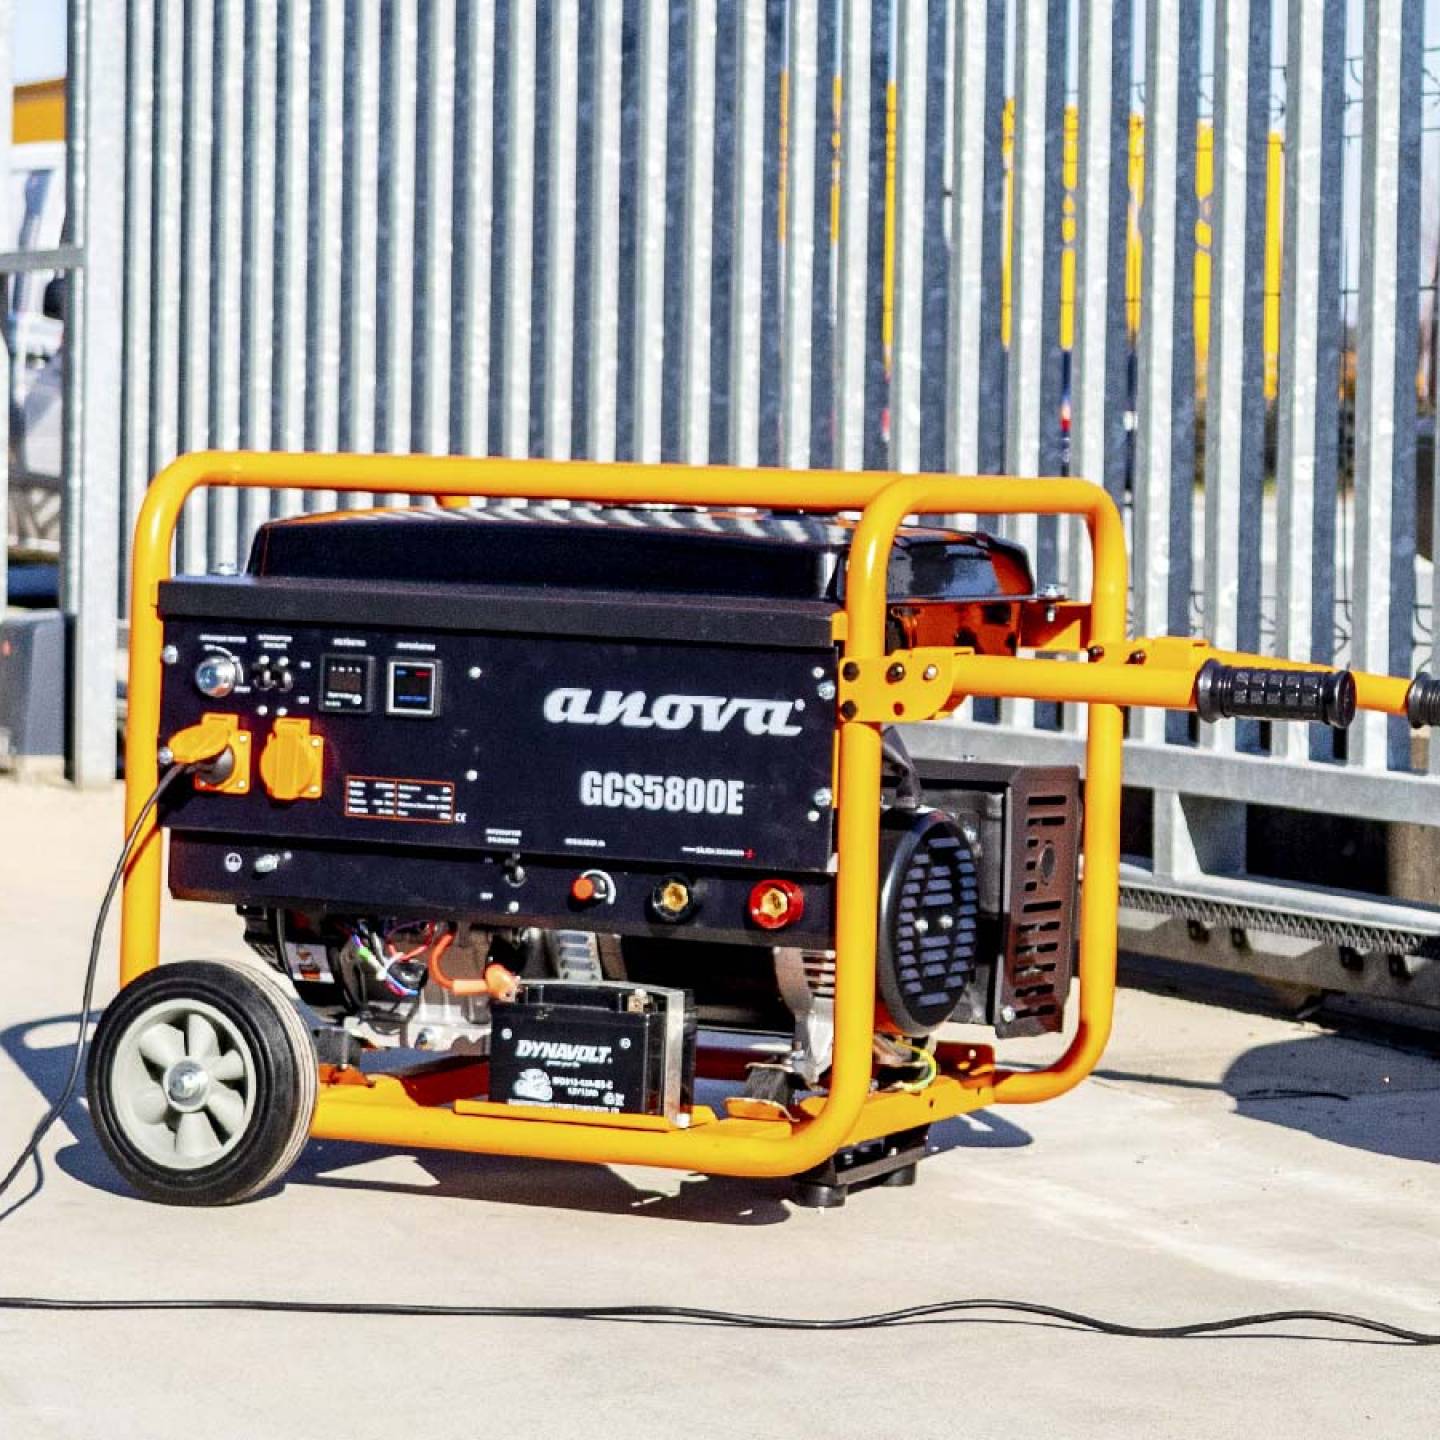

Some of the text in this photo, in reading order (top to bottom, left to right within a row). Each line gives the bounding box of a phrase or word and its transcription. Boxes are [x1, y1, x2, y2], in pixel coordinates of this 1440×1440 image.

[543, 687, 803, 736] anova
[580, 770, 745, 815] GCS5800E
[515, 1039, 612, 1064] DYNAVOLT
